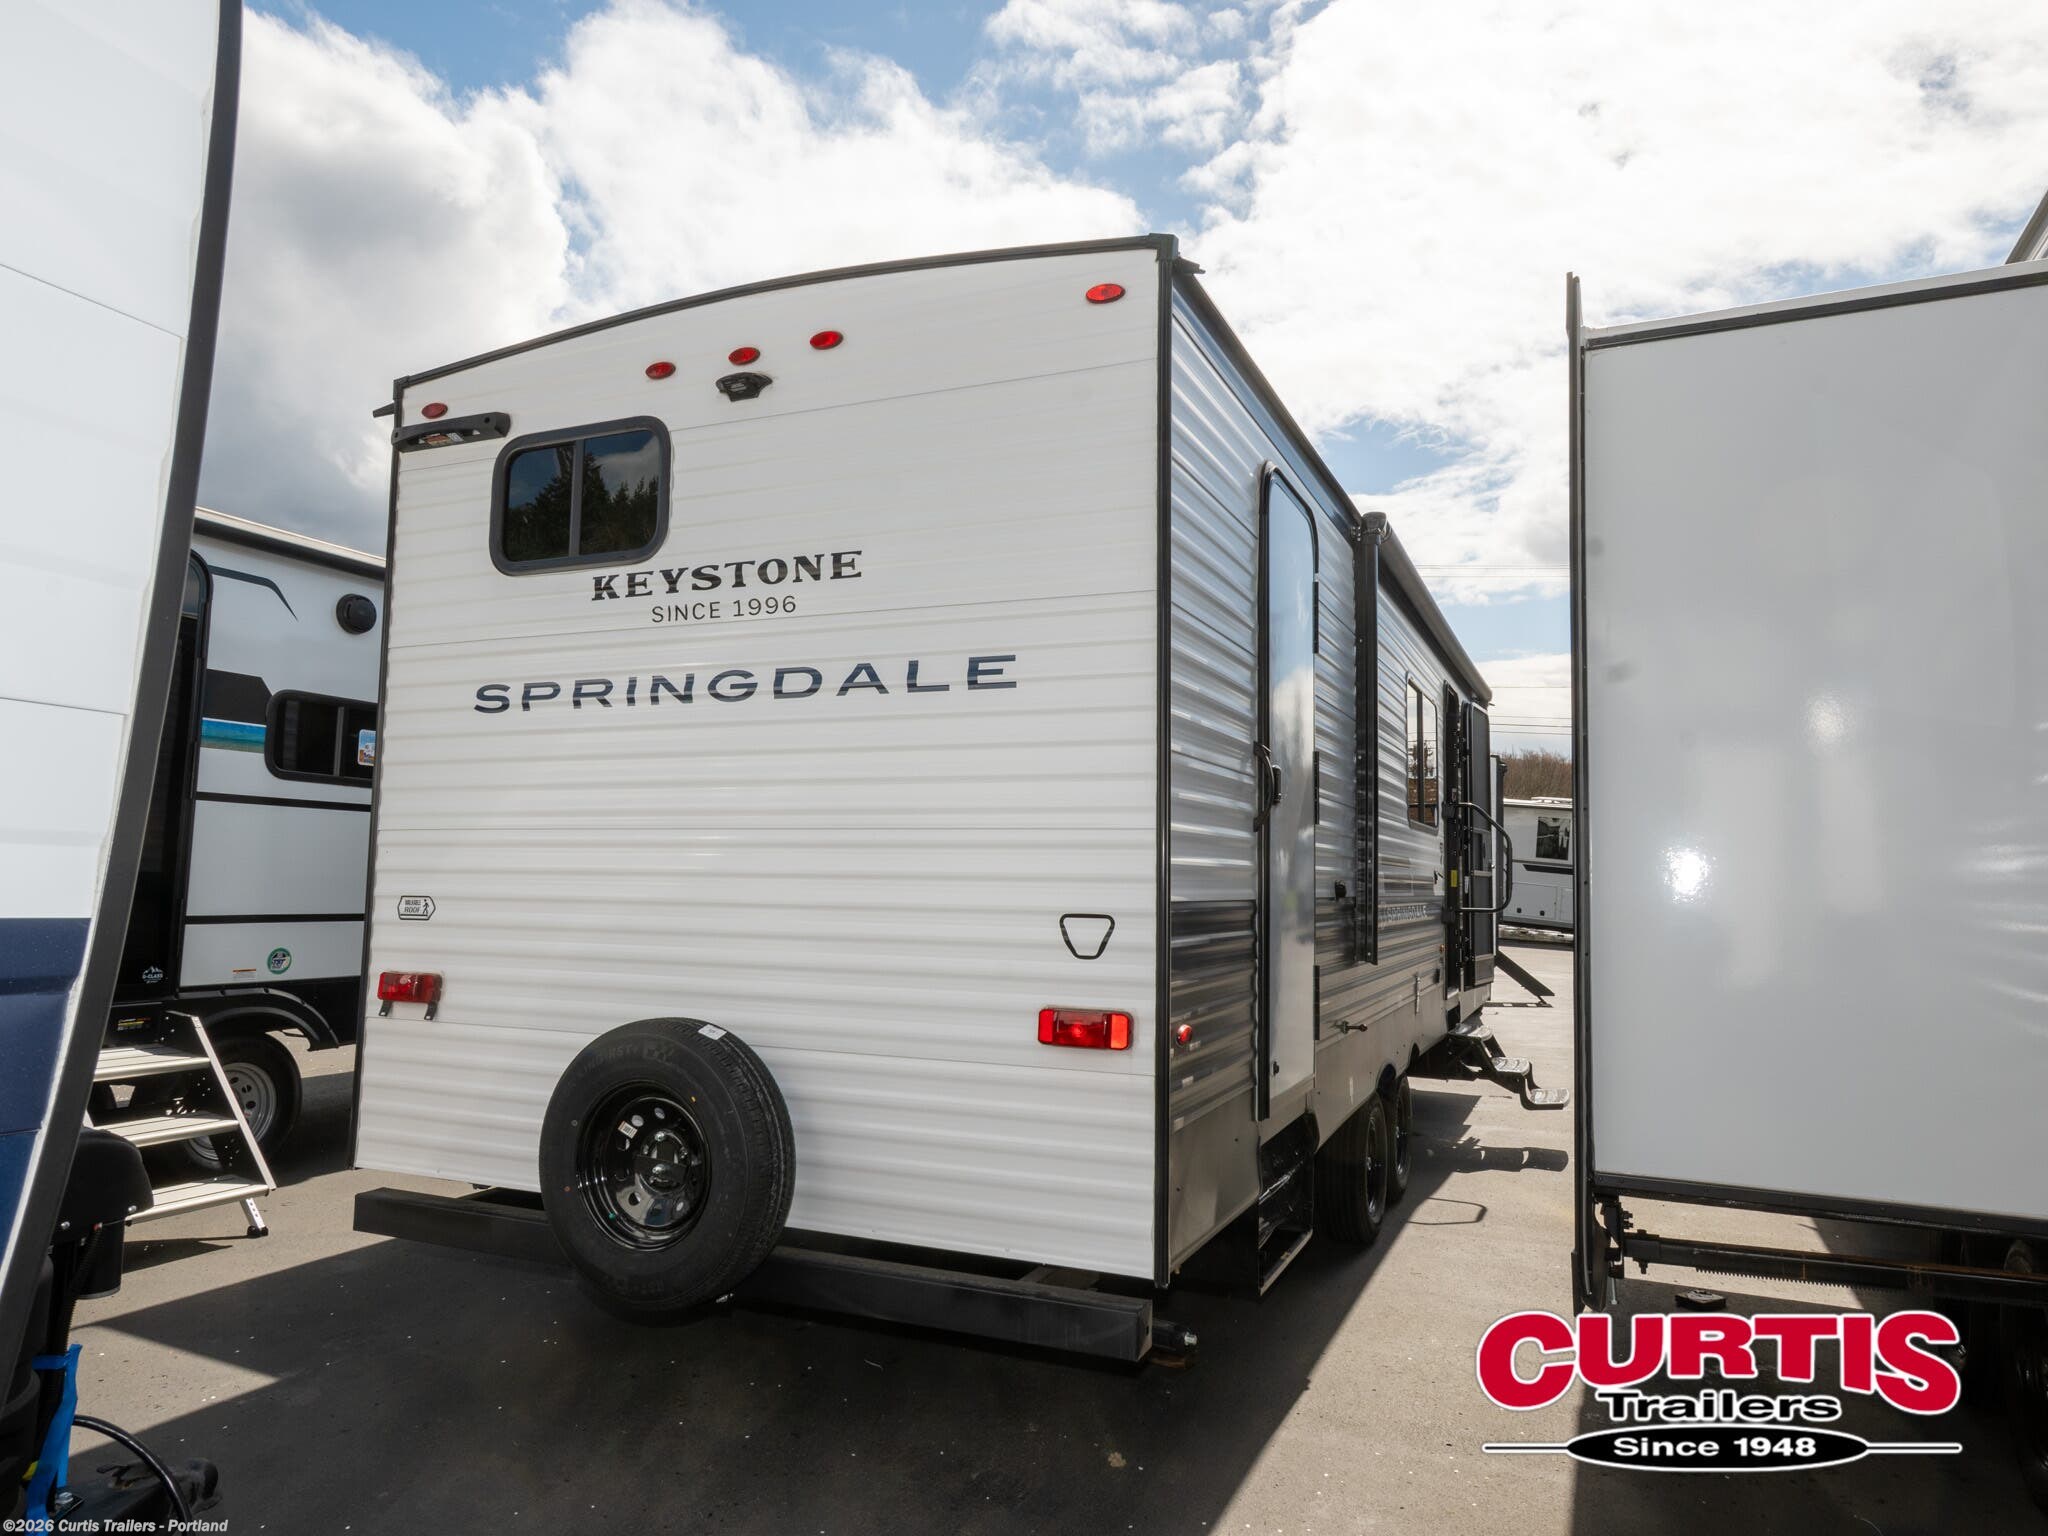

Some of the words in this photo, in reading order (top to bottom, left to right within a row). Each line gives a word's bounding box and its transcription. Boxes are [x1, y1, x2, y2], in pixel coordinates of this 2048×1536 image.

[592, 550, 863, 602] KEYSTONE
[652, 602, 721, 624] SINCE
[733, 596, 798, 618] 1996
[474, 654, 1017, 714] SPRINGDALE
